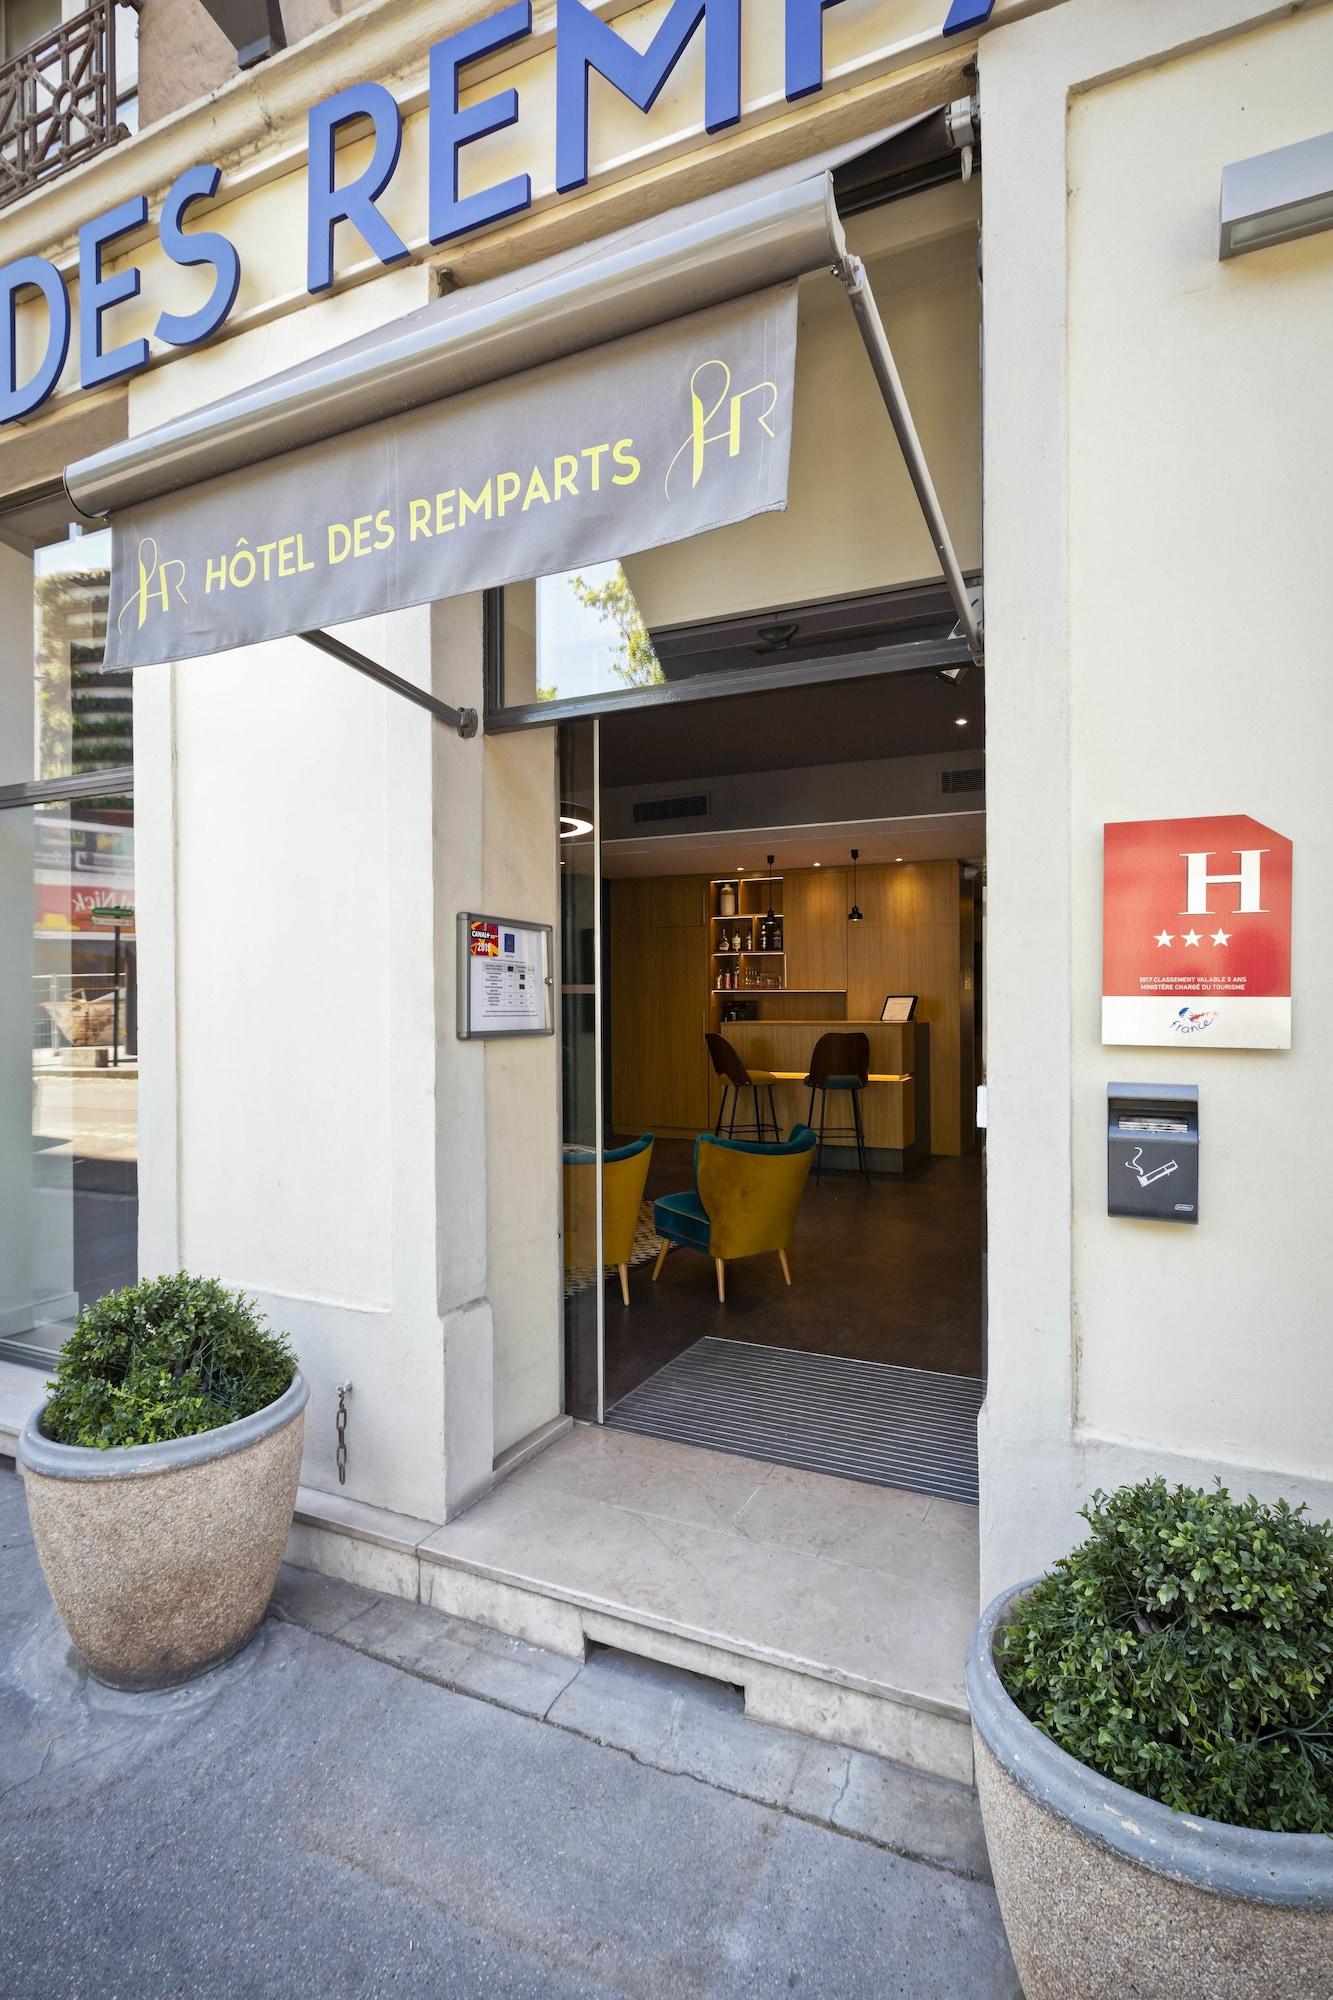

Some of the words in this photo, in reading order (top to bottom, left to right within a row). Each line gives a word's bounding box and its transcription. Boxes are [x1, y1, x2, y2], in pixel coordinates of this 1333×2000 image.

[0, 165, 240, 426] DES
[307, 0, 996, 294] REM
[205, 533, 315, 594] HÔTEL
[327, 510, 395, 565] DES
[409, 438, 641, 542] REMPARTS
[1178, 849, 1271, 915] H
